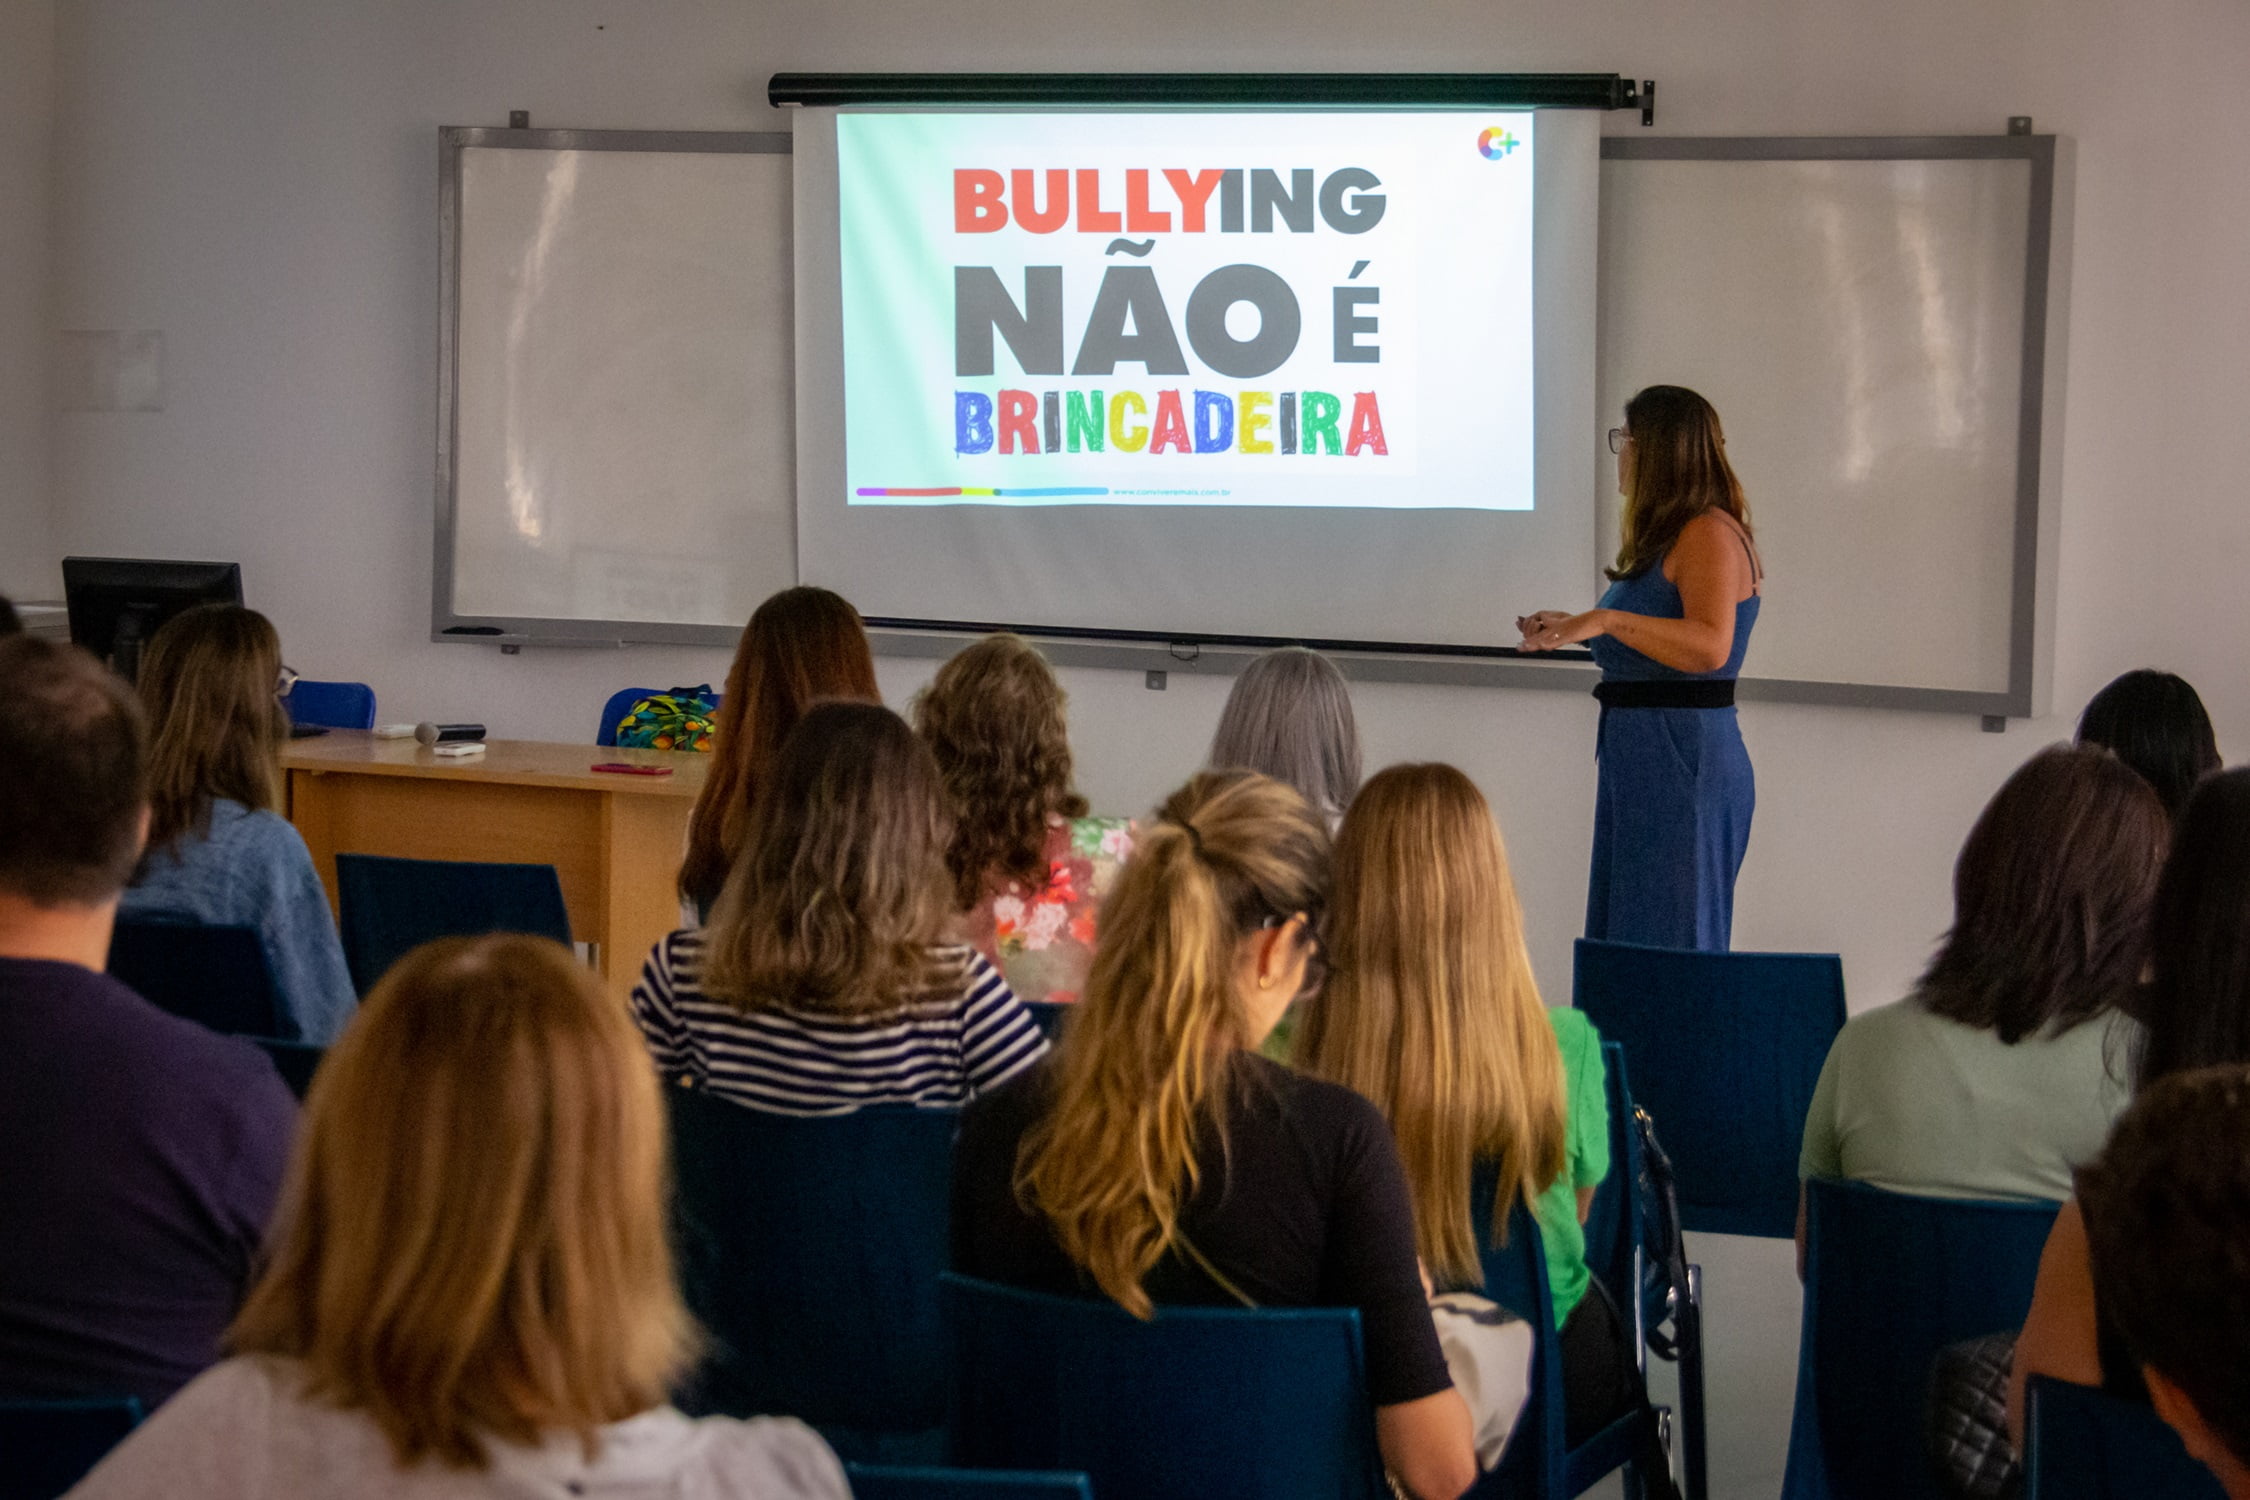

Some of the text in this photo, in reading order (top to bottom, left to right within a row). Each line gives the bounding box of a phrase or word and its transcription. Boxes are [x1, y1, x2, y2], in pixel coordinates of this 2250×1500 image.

[953, 167, 1387, 235] BULLYING
[953, 238, 1381, 379] NÃO É
[953, 389, 1390, 458] BRINCADEIRA
